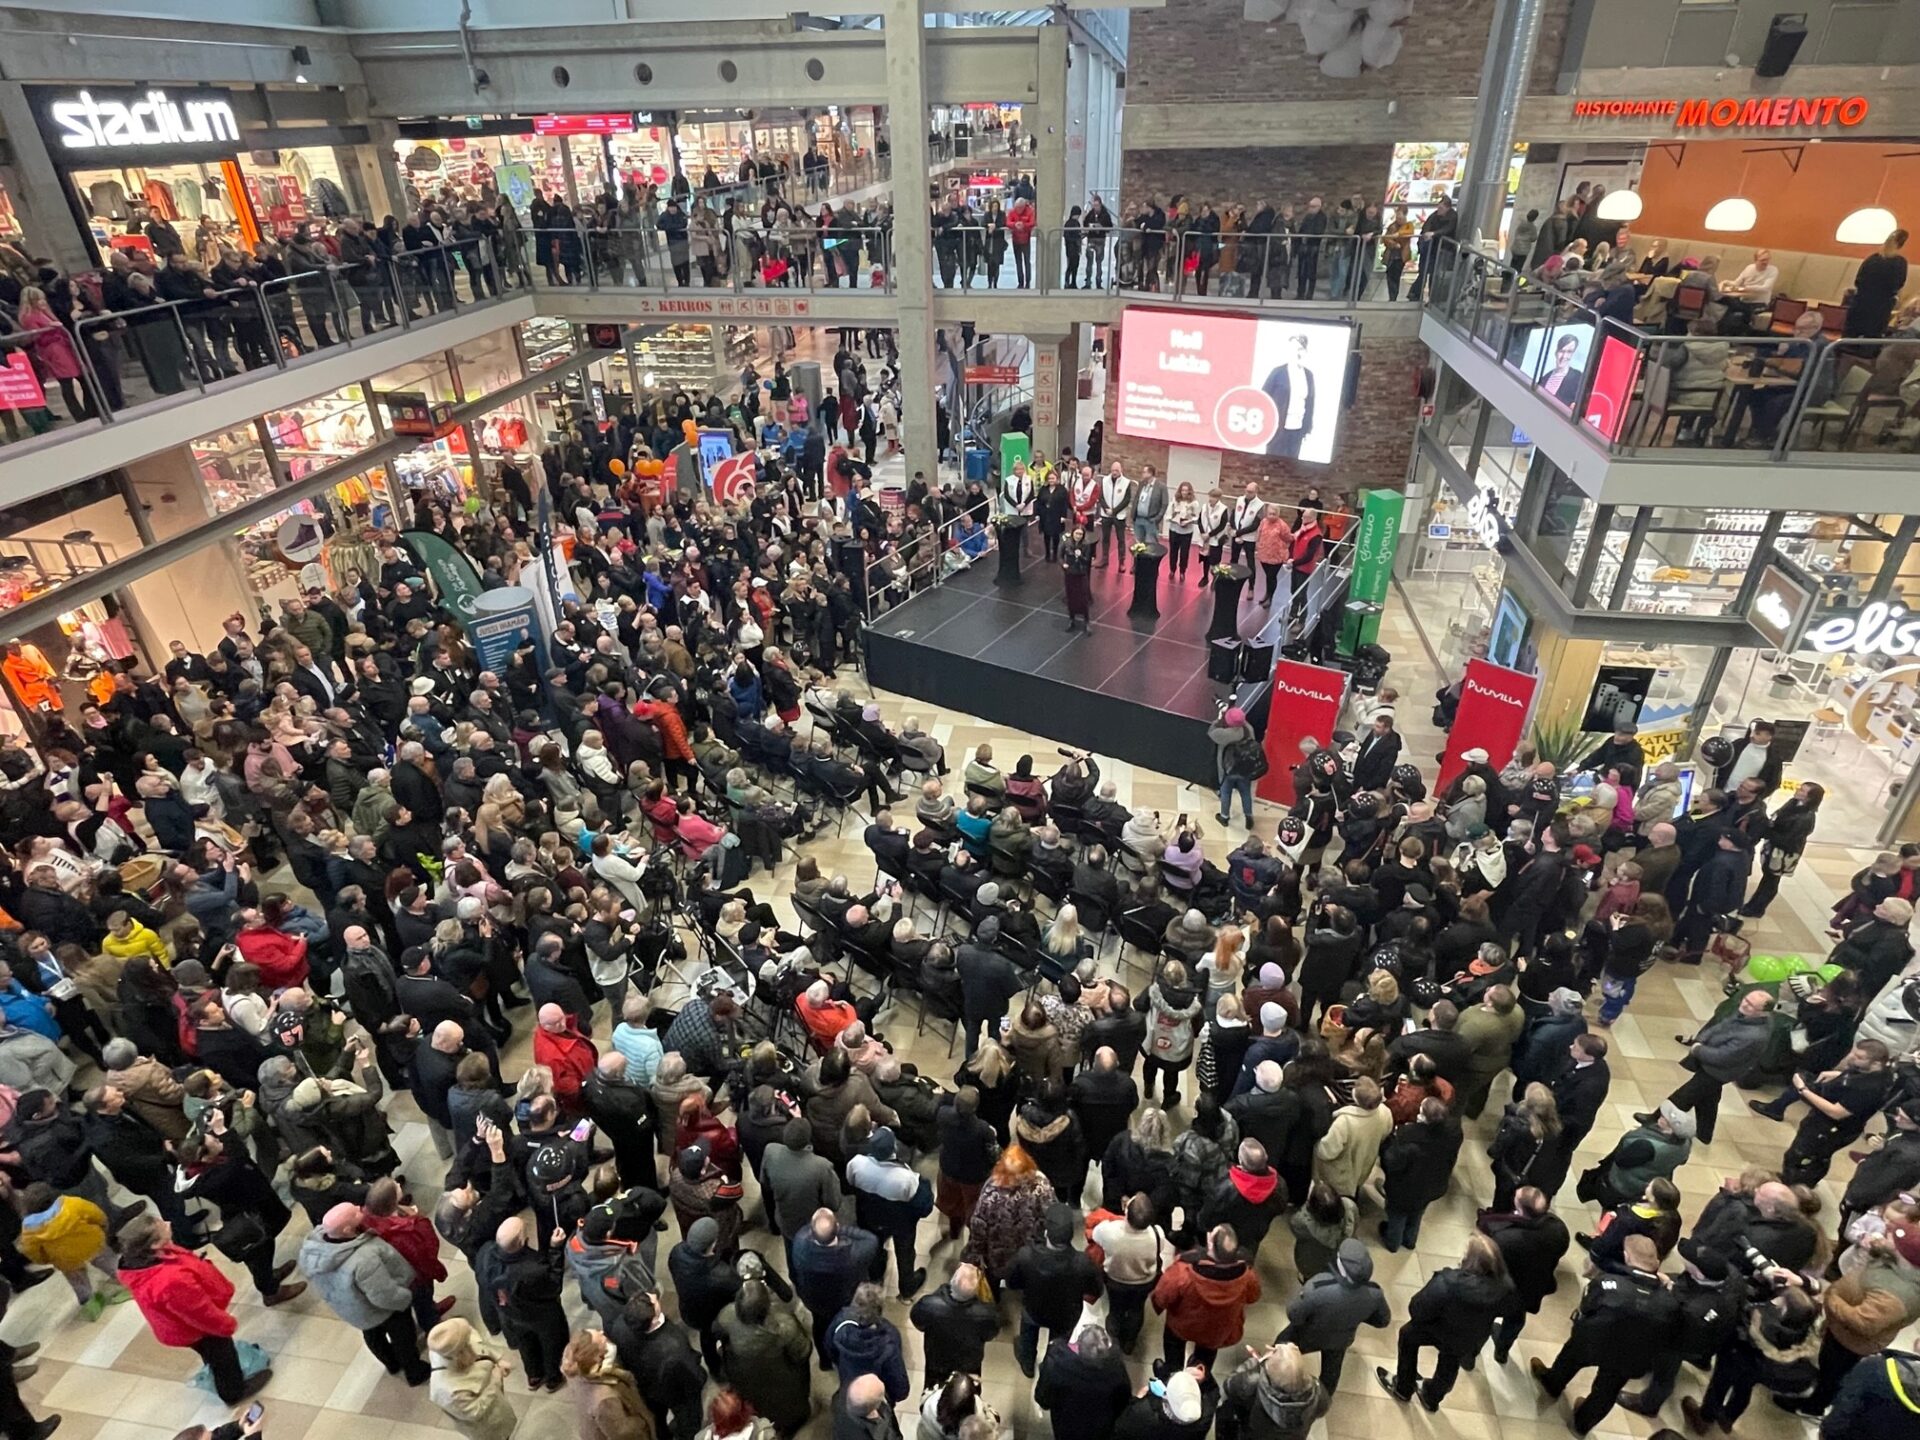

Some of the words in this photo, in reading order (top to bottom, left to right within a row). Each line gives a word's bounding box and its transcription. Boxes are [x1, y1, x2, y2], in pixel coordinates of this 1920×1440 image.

[53, 90, 240, 148] stadium
[1576, 101, 1678, 116] RISTORANTE
[1677, 97, 1868, 128] MOMENTO
[659, 300, 712, 312] KERROS
[1228, 405, 1264, 435] 58
[1804, 602, 1920, 656] elis
[1638, 732, 1683, 746] ATUT
[1281, 829, 1299, 845] 57
[280, 1024, 304, 1047] 57
